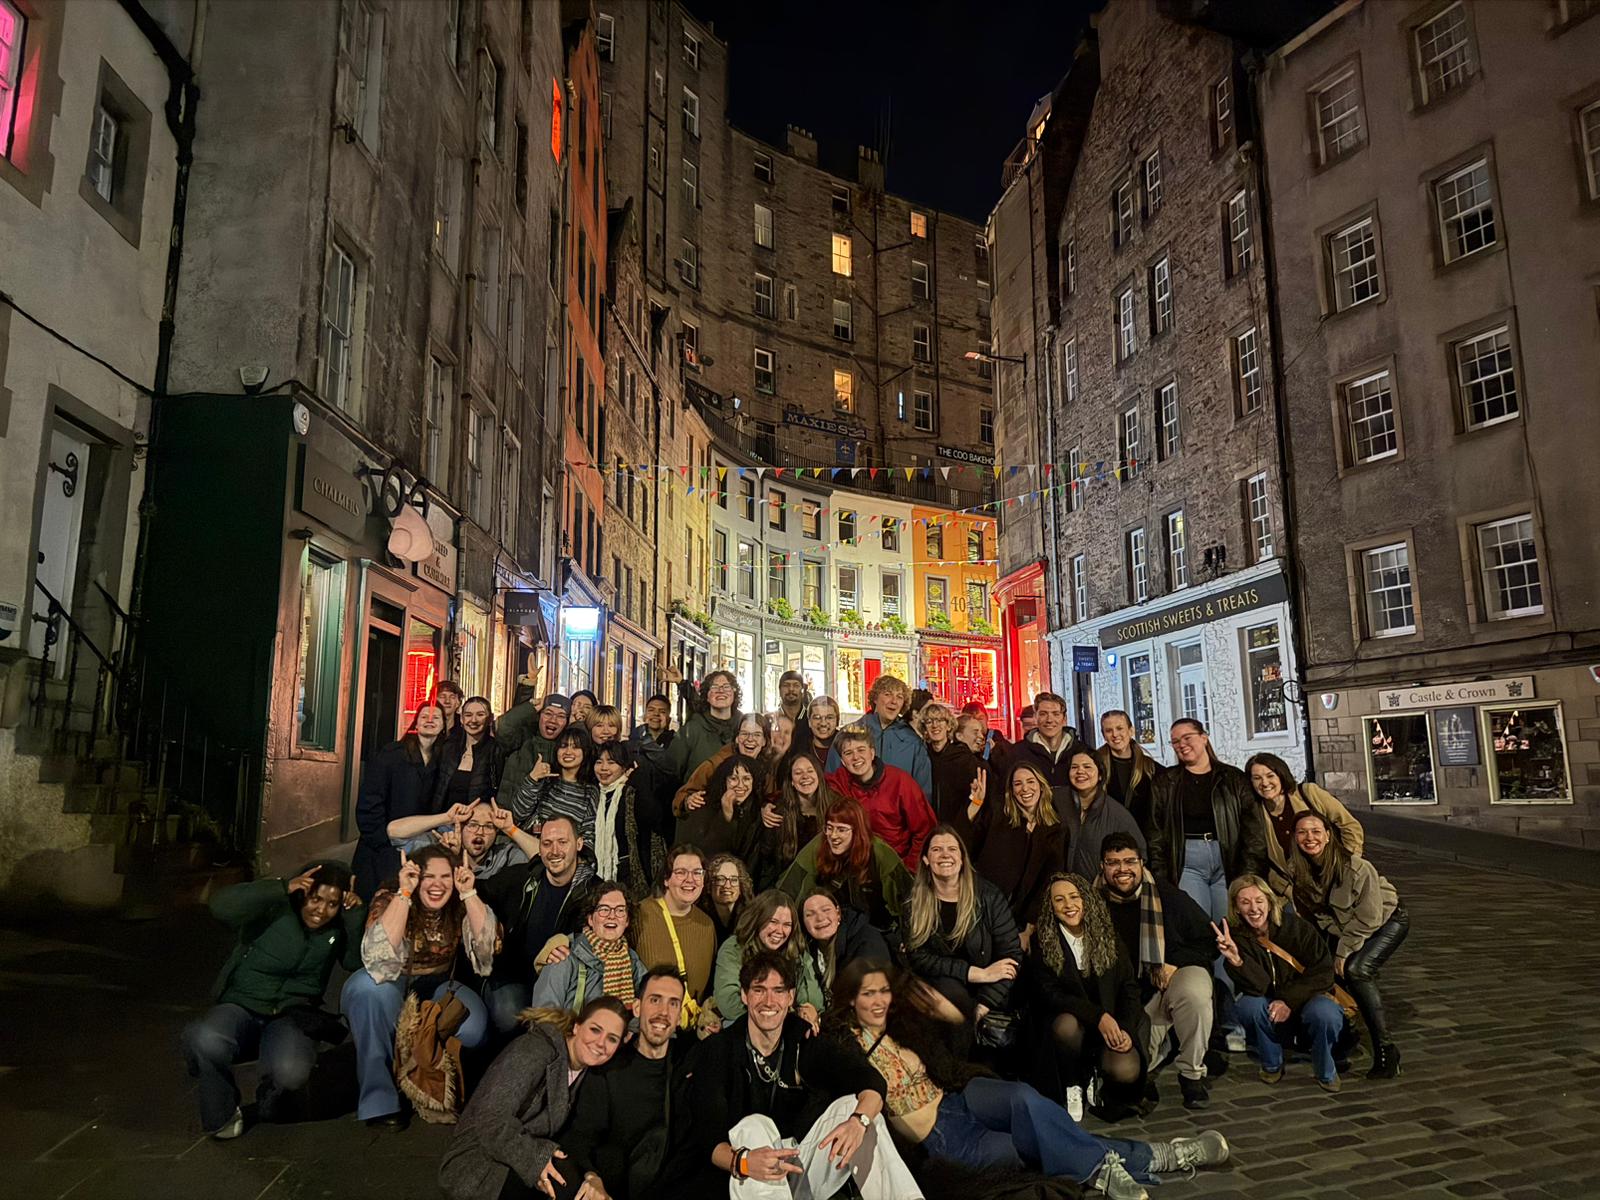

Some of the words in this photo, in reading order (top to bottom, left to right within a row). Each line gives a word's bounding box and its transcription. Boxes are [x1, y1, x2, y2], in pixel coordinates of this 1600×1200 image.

[786, 413, 849, 435] MAXIES
[938, 446, 952, 457] THE
[953, 450, 968, 460] COO
[950, 596, 966, 612] 40
[1117, 617, 1161, 641] SCOTTISH
[1163, 605, 1203, 628] SWEETS
[1206, 602, 1214, 616] &
[1216, 589, 1259, 613] TREATS
[1409, 691, 1442, 703] Castle
[1445, 689, 1455, 700] &
[1458, 688, 1496, 699] Crown
